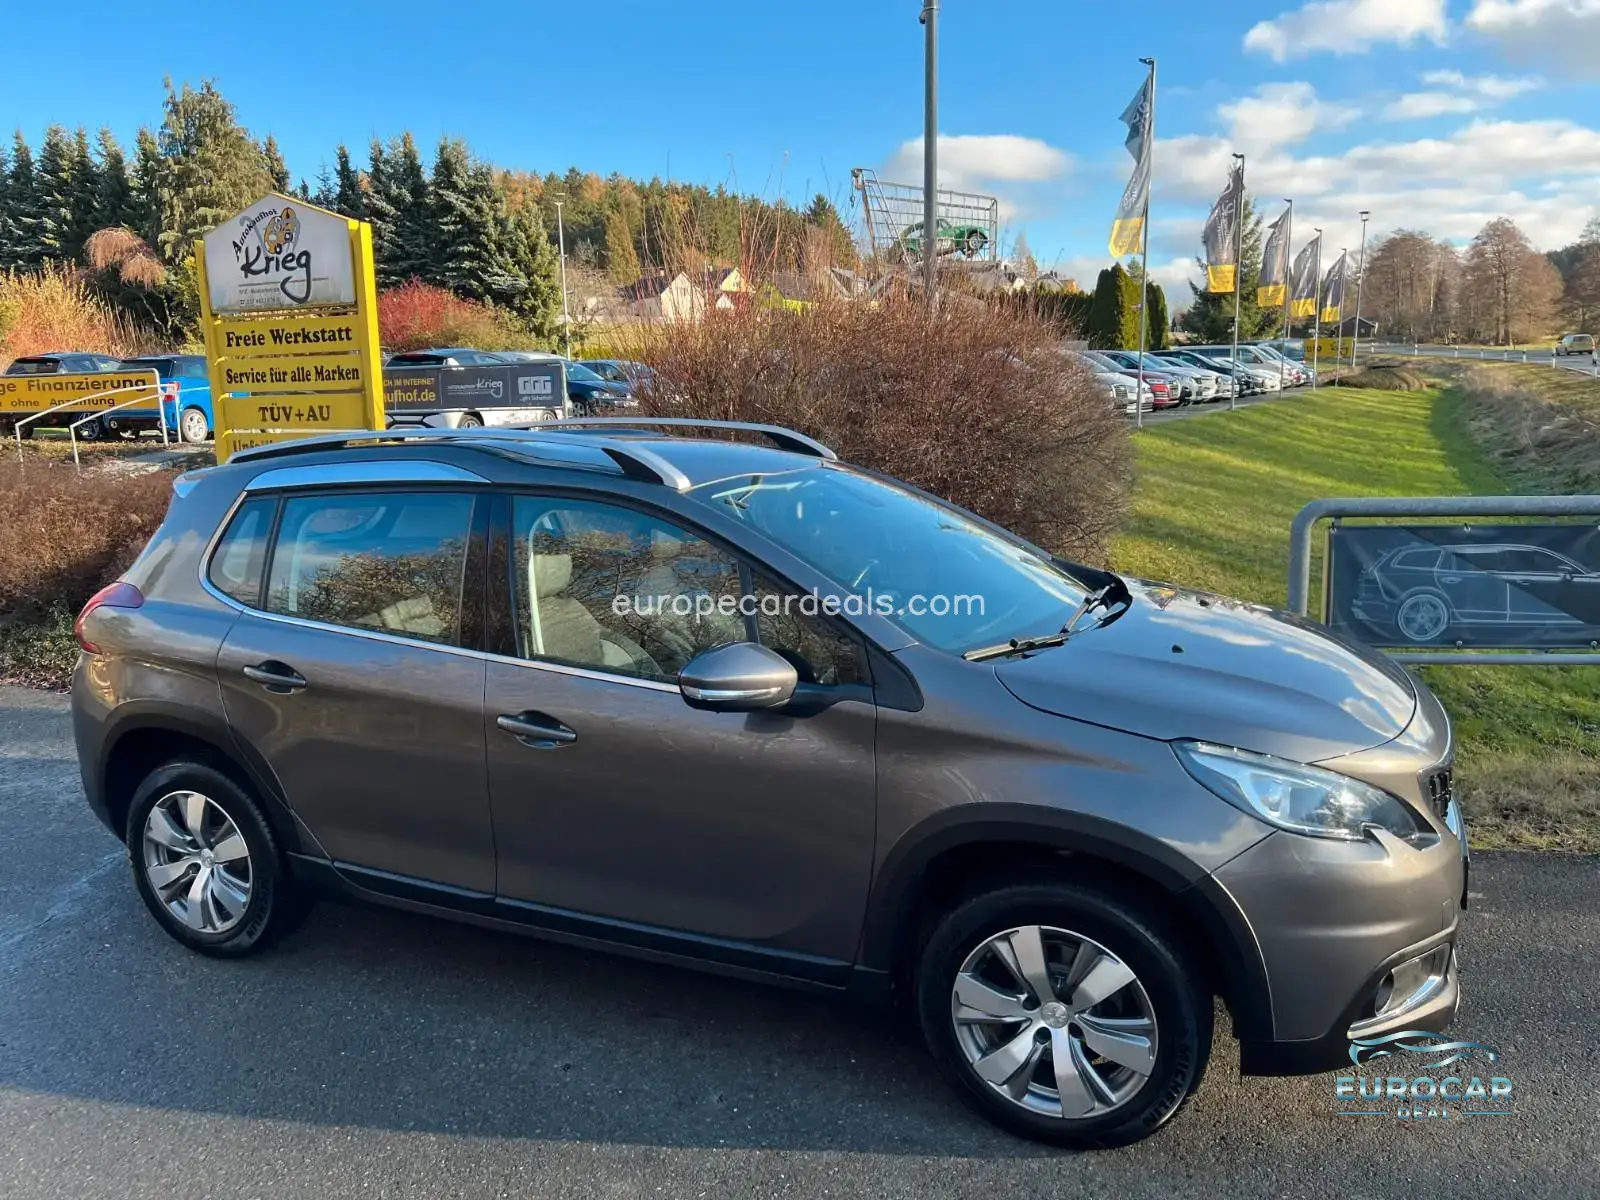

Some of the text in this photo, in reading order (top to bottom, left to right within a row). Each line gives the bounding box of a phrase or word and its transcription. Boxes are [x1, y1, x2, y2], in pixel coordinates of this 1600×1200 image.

[232, 208, 280, 262] Autokaufhof
[240, 244, 312, 304] Krieg
[225, 326, 352, 348] Freie Werkstatt
[27, 377, 147, 392] Finanzierung
[226, 365, 360, 384] Service für alle Marken
[476, 377, 503, 398] Krieg
[11, 398, 40, 407] ohne
[258, 402, 331, 423] TÜV+AU
